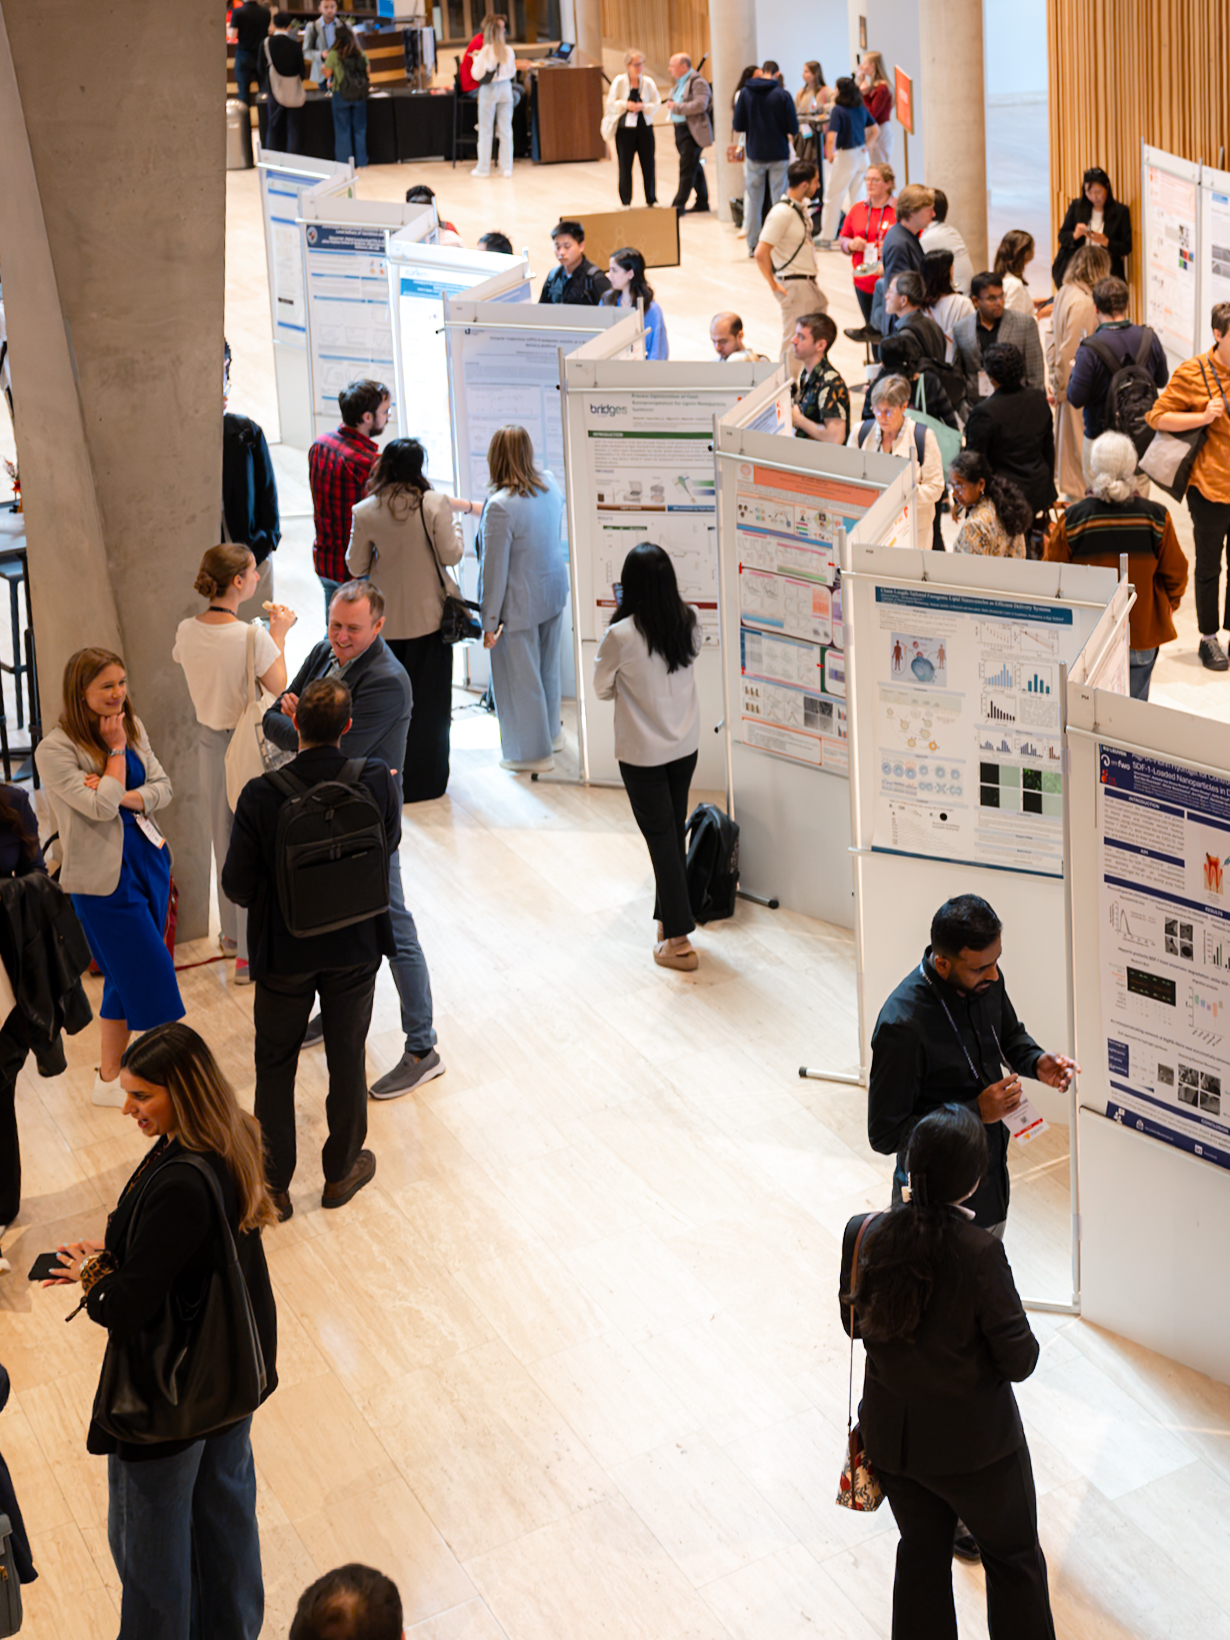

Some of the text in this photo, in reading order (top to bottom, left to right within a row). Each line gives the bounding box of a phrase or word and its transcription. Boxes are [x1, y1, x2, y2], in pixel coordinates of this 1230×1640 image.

[589, 403, 628, 417] bridges
[1117, 759, 1131, 771] fwo
[1176, 773, 1219, 794] Nanoparticles
[1220, 787, 1226, 795] in
[1128, 796, 1160, 809] INTRODUCTION
[1205, 906, 1223, 917] RESULTS
[1201, 1118, 1229, 1133] CONCLUSION
